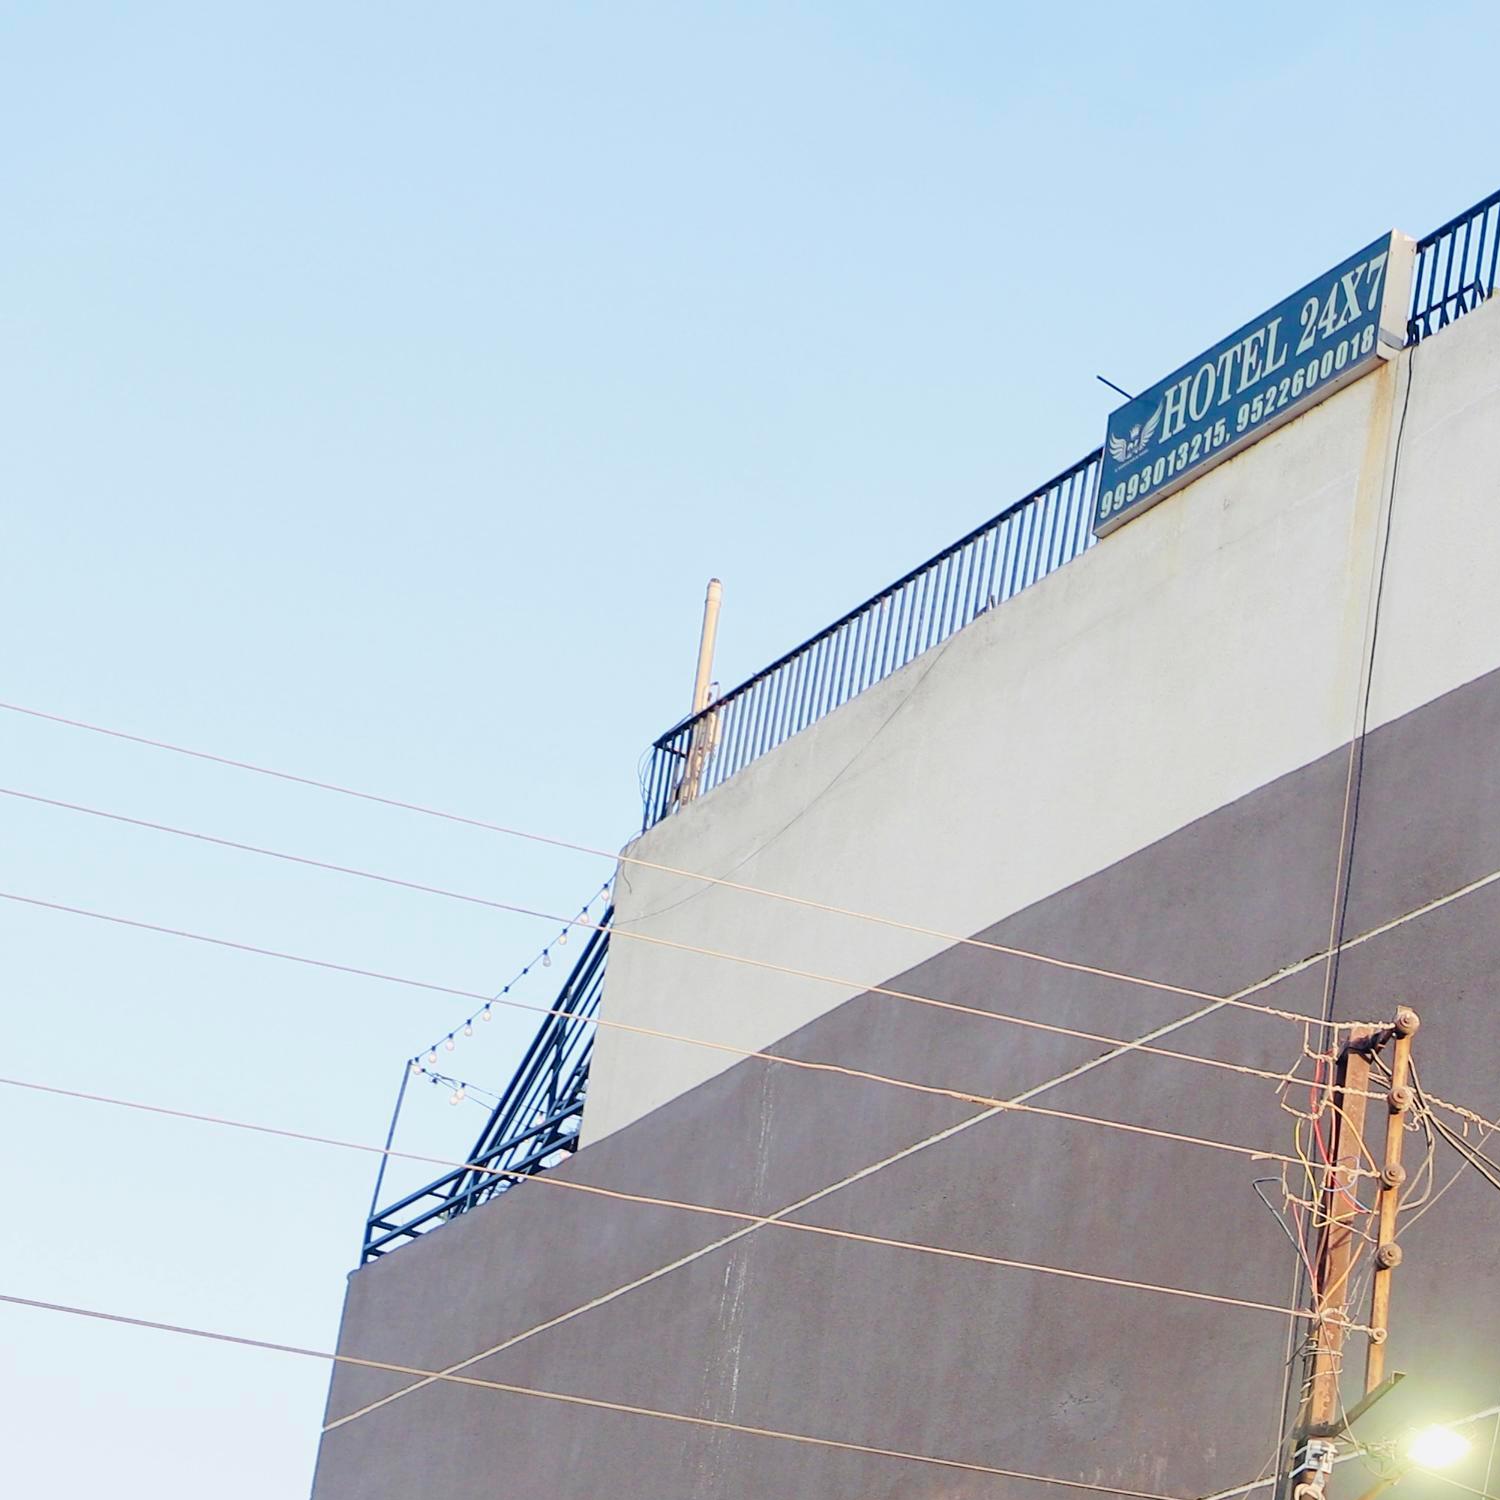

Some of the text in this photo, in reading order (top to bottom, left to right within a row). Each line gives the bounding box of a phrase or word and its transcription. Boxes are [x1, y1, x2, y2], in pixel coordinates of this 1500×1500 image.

[1158, 251, 1387, 443] HOTEL 24X7
[1237, 324, 1375, 432] 9522600018
